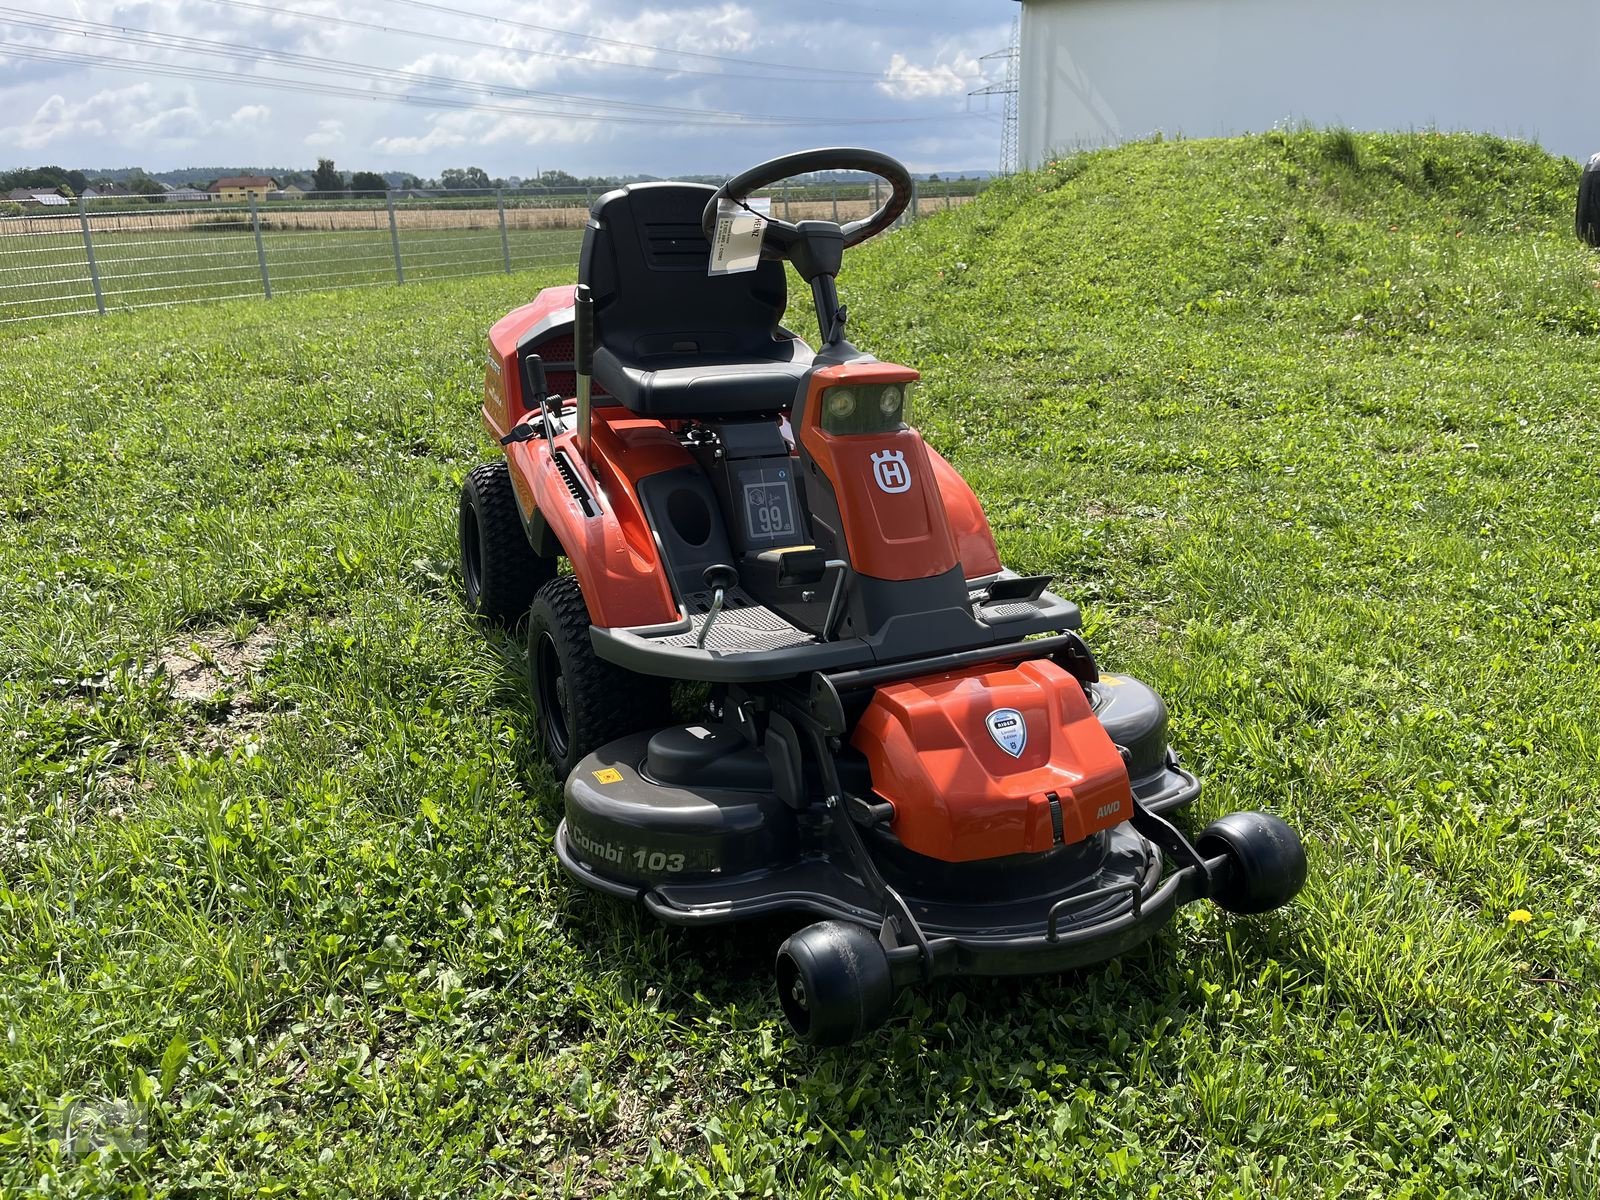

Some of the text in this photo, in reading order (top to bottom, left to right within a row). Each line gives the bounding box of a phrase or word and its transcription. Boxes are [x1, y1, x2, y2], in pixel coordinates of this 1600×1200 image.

[752, 218, 762, 237] HEINZ
[758, 506, 782, 531] 99
[1097, 800, 1120, 819] AWD
[573, 826, 685, 872] Combi 103
